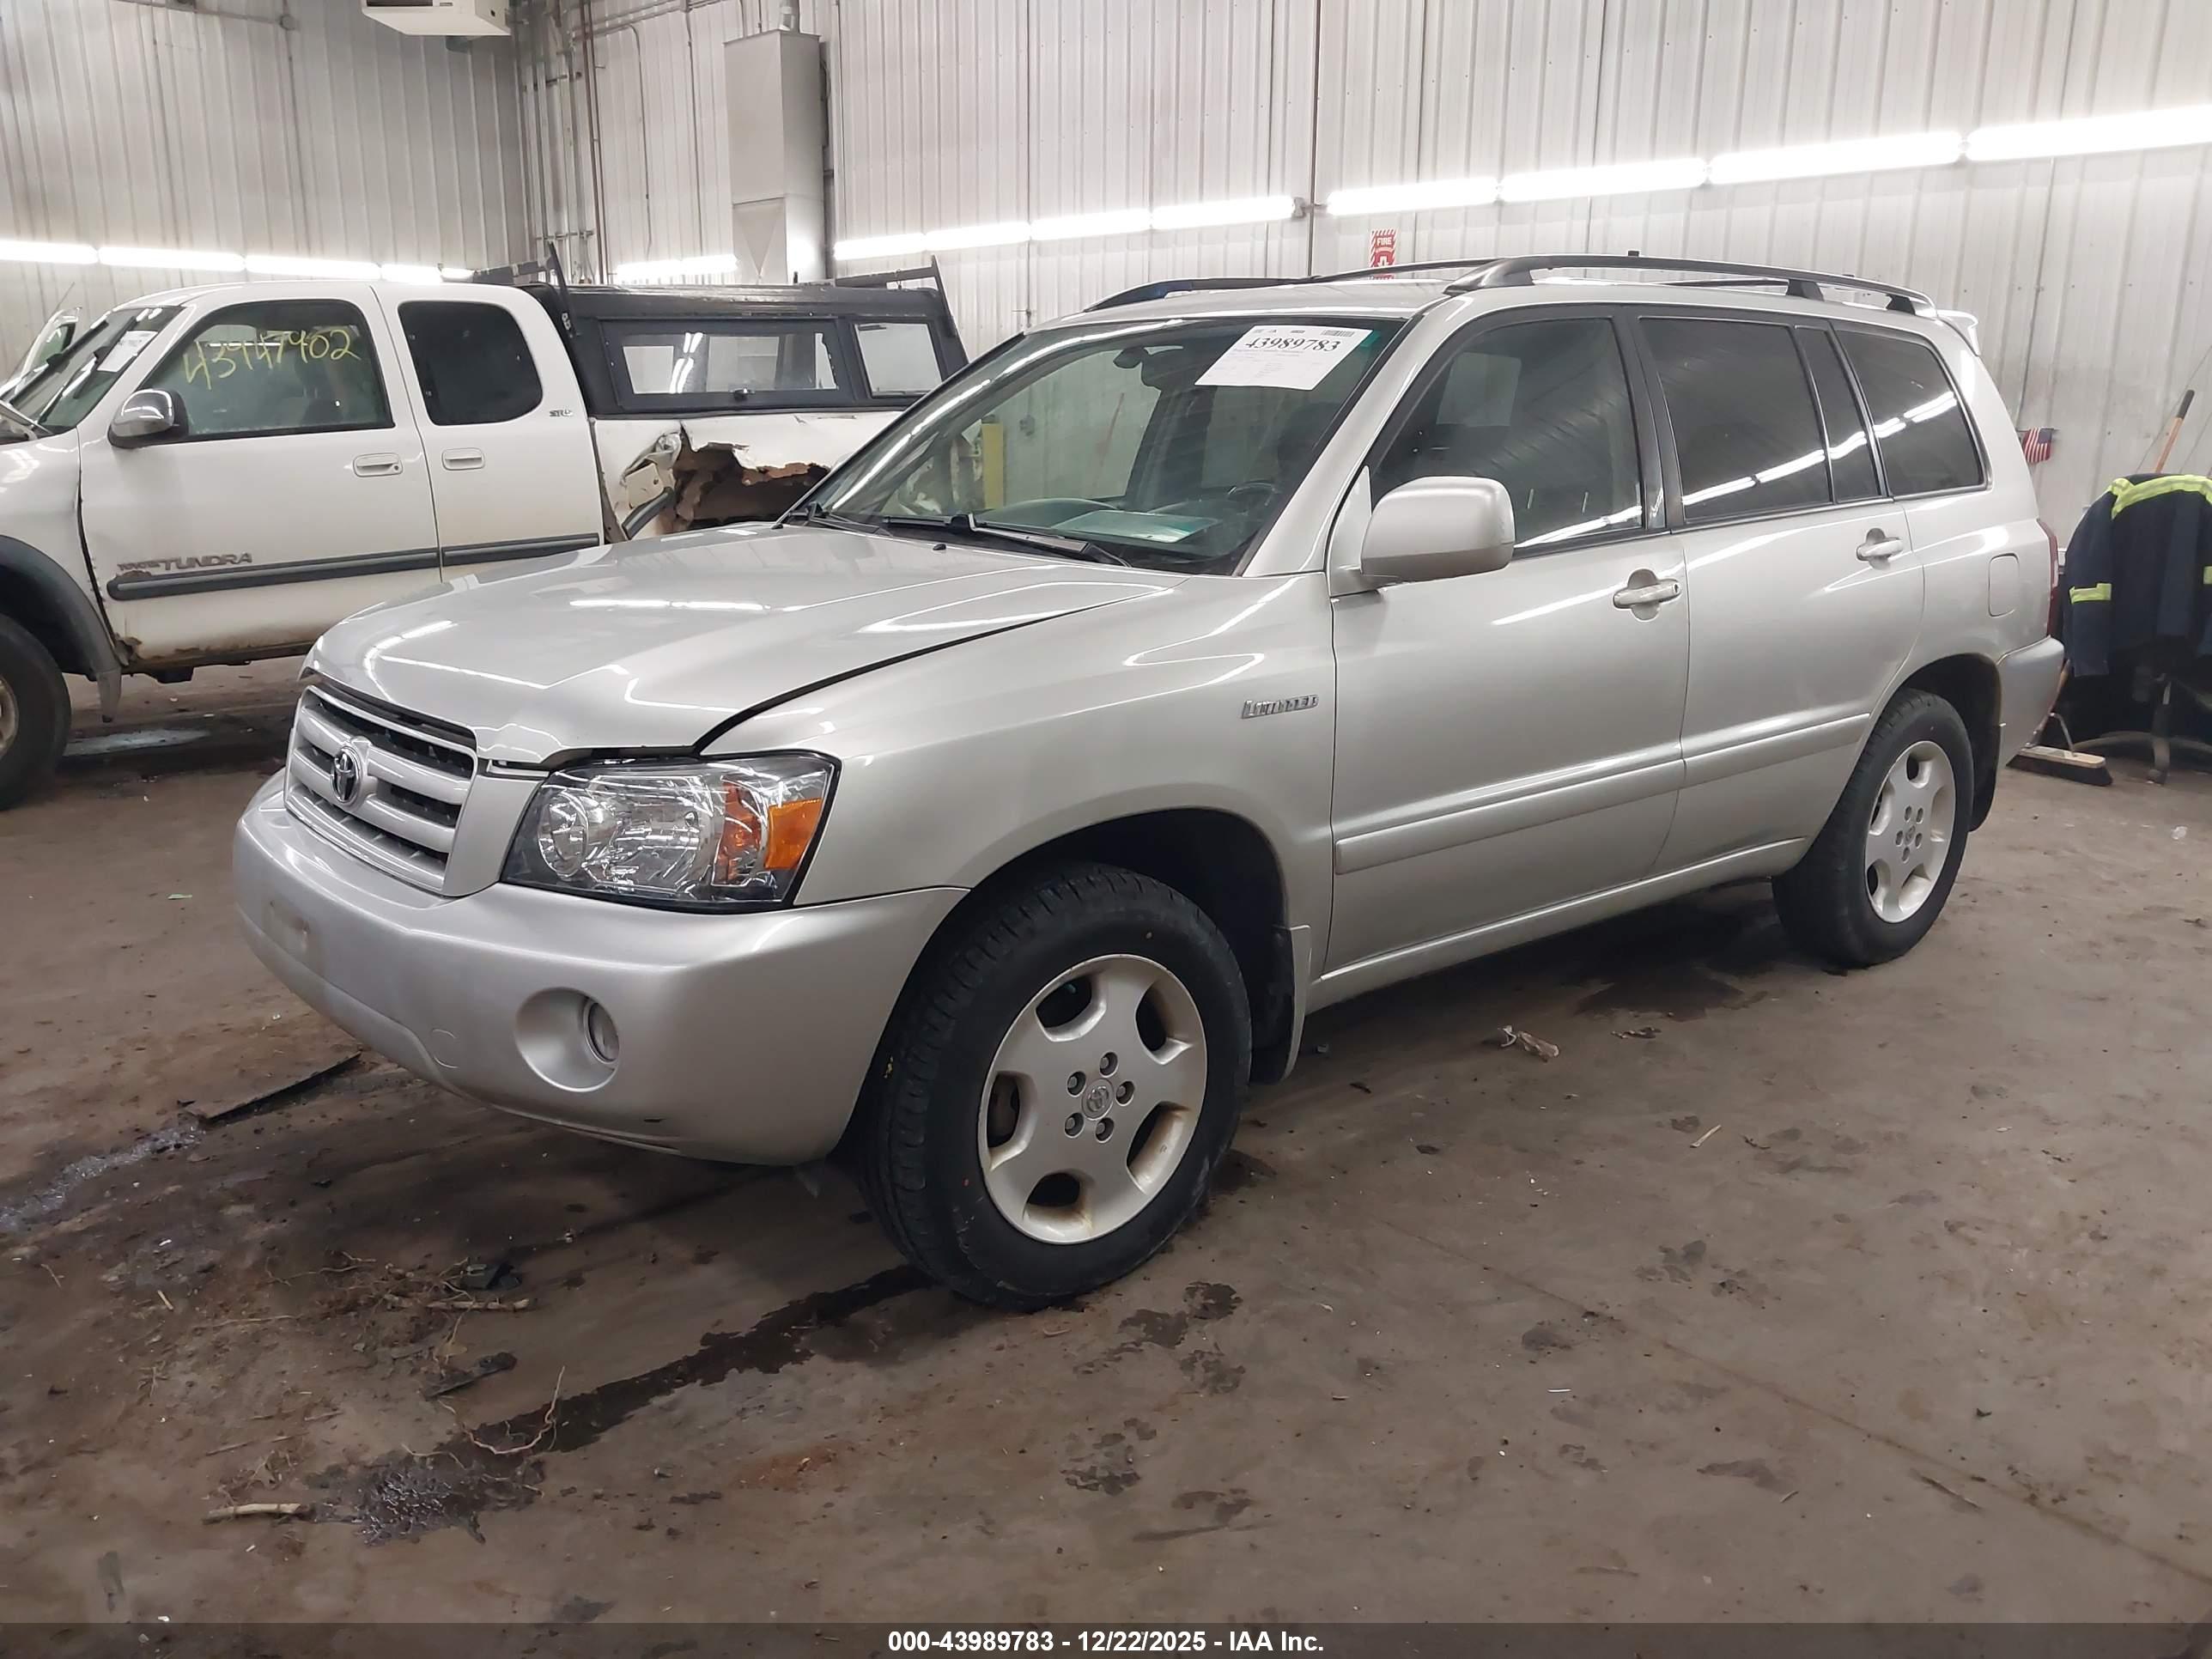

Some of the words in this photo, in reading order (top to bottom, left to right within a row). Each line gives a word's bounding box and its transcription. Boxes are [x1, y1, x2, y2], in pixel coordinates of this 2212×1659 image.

[1376, 236, 1392, 246] FIRE
[1244, 337, 1341, 352] 43989783
[182, 329, 362, 390] 43947902
[156, 552, 252, 571] TUNDRA
